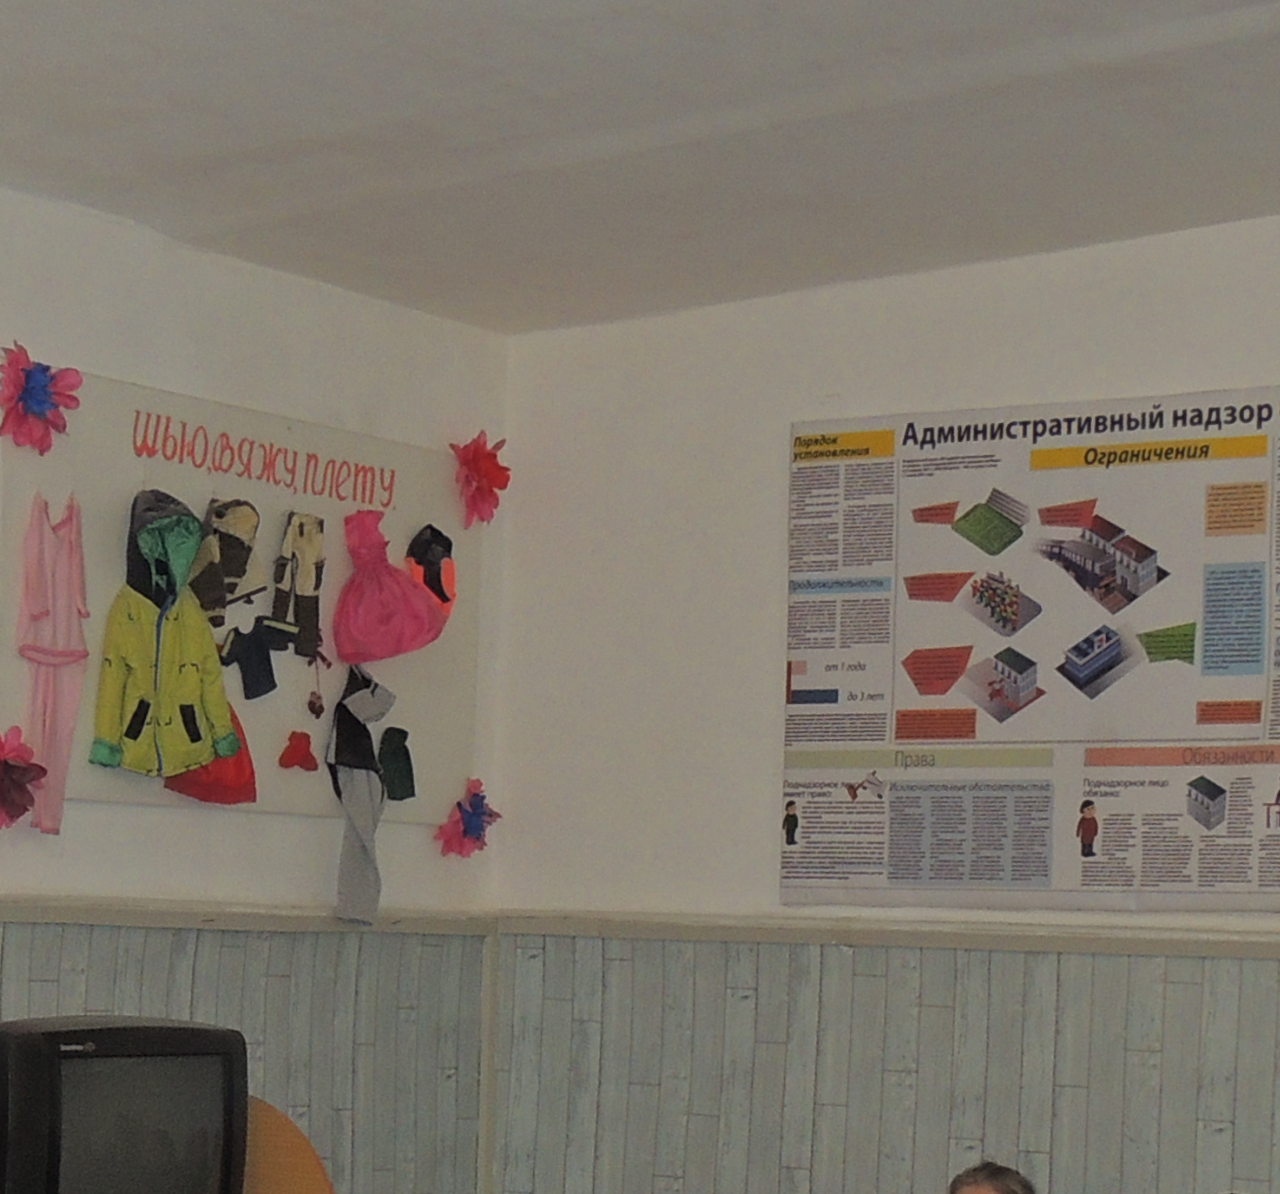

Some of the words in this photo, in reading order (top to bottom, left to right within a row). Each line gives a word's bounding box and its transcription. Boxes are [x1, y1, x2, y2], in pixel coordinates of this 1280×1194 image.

[902, 403, 1164, 450] Административный
[1172, 402, 1272, 430] надзор
[793, 435, 838, 449] Порядок
[792, 447, 869, 462] установления
[1084, 444, 1210, 469] Ограничения
[894, 750, 935, 769] Права
[1182, 747, 1275, 765] Обязанности
